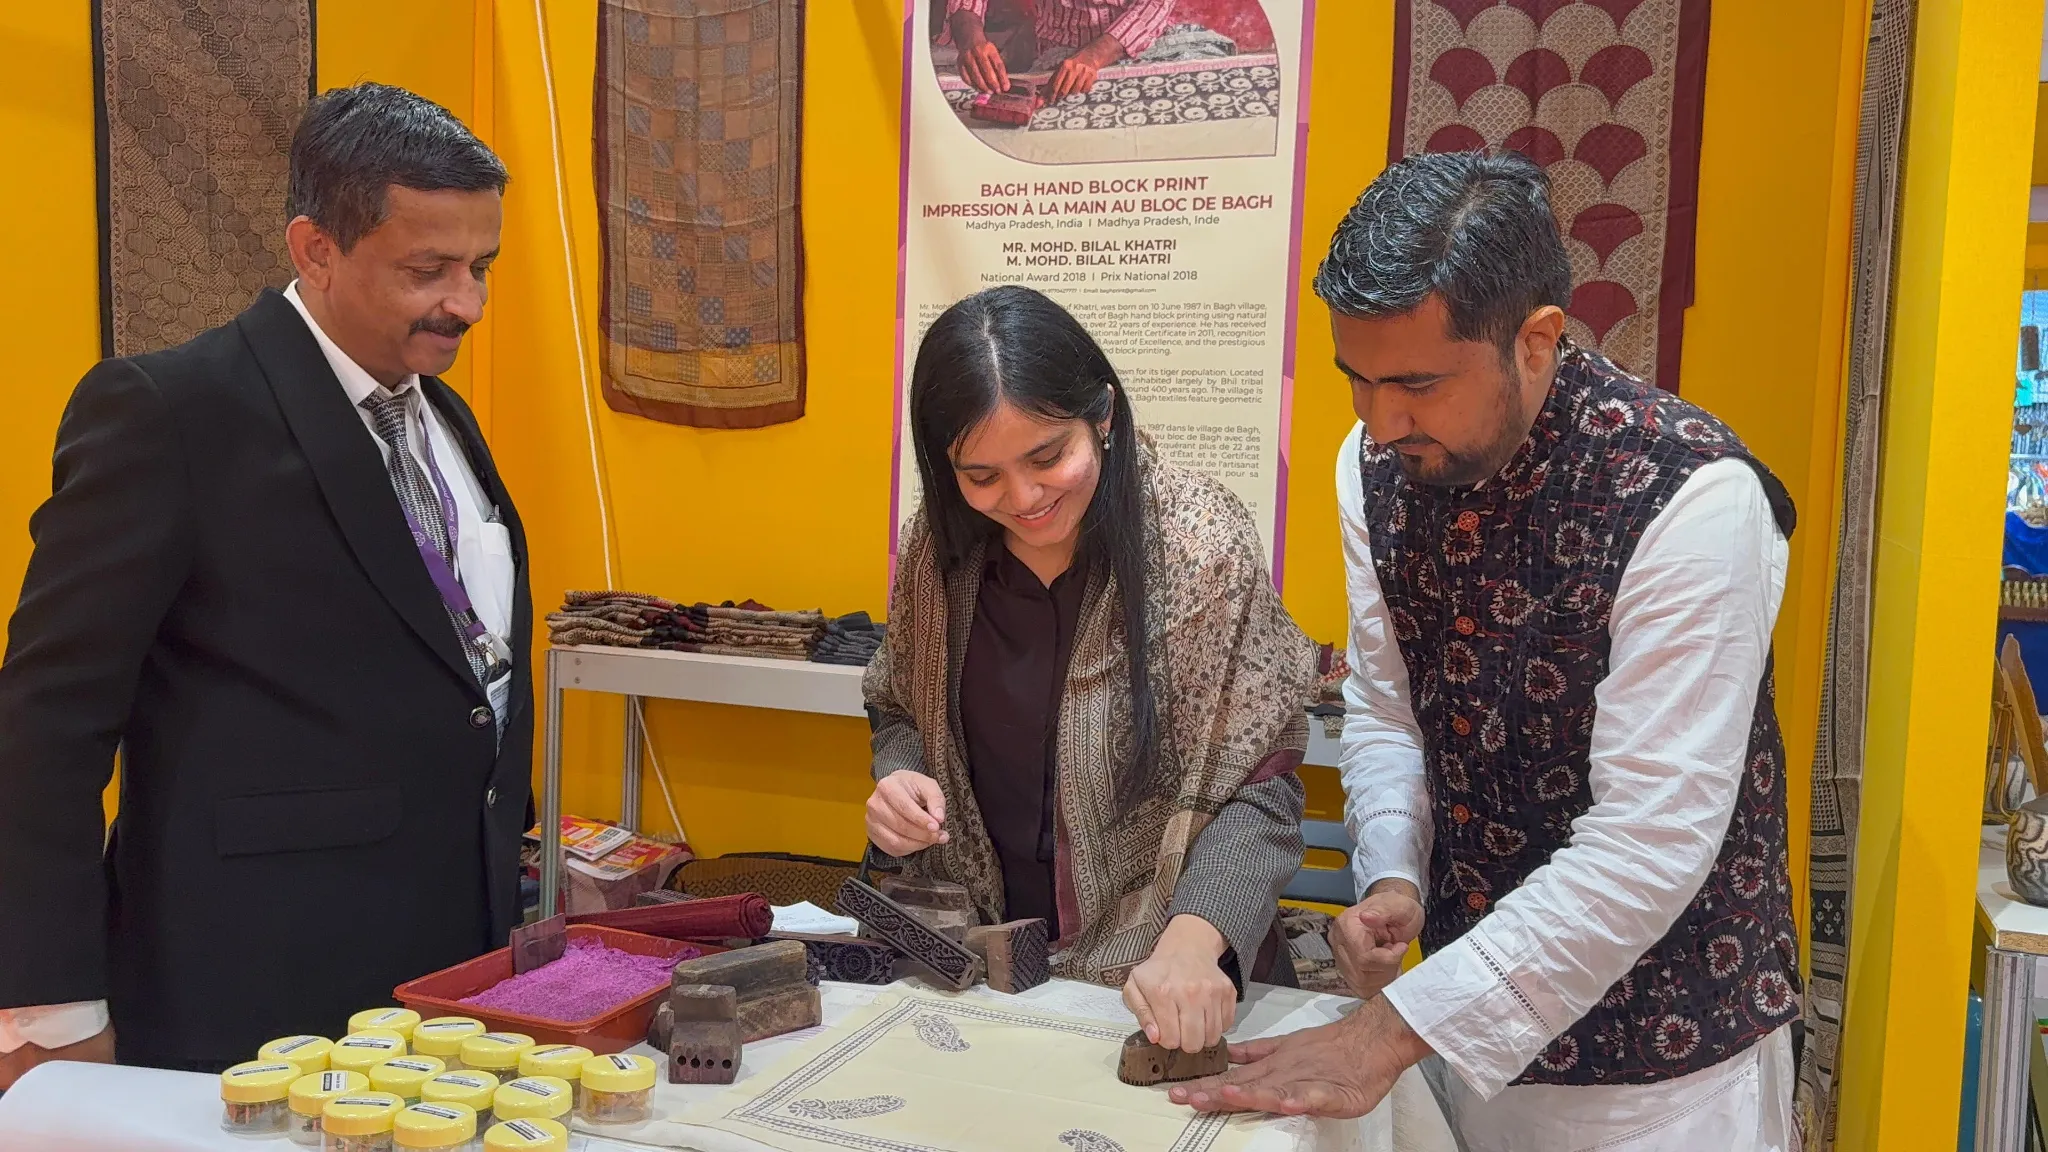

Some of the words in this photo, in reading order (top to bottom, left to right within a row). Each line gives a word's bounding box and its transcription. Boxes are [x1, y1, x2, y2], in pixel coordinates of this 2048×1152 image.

[981, 182, 1028, 197] BAGH
[1033, 180, 1084, 195] HAND
[1089, 178, 1149, 194] BLOCK
[1154, 176, 1209, 192] PRINT
[922, 201, 1018, 217] IMPRESSION
[1022, 197, 1034, 215] À
[1039, 200, 1059, 214] LA
[1064, 199, 1106, 214] MAIN
[1110, 198, 1135, 212] AU
[1140, 197, 1187, 212] BLOC
[1192, 196, 1216, 210] DE
[1221, 195, 1272, 210] BAGH
[965, 219, 1006, 232] Madhya
[1008, 218, 1054, 230] Pradesh,
[1056, 217, 1083, 228] India
[1097, 216, 1140, 229] Madhya
[1143, 215, 1191, 227] Pradesh,
[1194, 214, 1220, 225] Inde
[1002, 241, 1026, 253] MR.
[1030, 240, 1077, 252] MOHD.
[1081, 240, 1121, 251] BILAL
[1124, 239, 1176, 251] KHATRI
[1006, 255, 1021, 266] M.
[1025, 254, 1071, 266] MOHD.
[1075, 254, 1115, 265] BILAL
[1119, 253, 1170, 265] KHATRI
[980, 271, 1024, 282] National
[1025, 271, 1060, 281] Award
[1062, 271, 1086, 281] 2018
[1100, 270, 1121, 281] Prix
[1123, 270, 1170, 280] National
[1172, 270, 1197, 280] 2018
[1073, 302, 1099, 311] Khatri,
[1117, 302, 1137, 310] born
[1150, 302, 1160, 310] 10
[1161, 301, 1181, 310] June
[1183, 301, 1202, 310] 1987
[1203, 301, 1211, 310] in
[1213, 301, 1236, 311] Bagh
[1237, 301, 1267, 311] village,
[1078, 311, 1097, 319] craft
[1097, 311, 1106, 319] of
[1107, 311, 1129, 321] Bagh
[1130, 310, 1152, 319] hand
[1152, 310, 1175, 319] block
[1176, 310, 1210, 320] printing
[1211, 310, 1235, 320] using
[1236, 310, 1267, 318] natural
[1107, 319, 1117, 327] 22
[1118, 321, 1140, 329] years
[1141, 319, 1150, 327] of
[1151, 319, 1196, 329] experience.
[1199, 319, 1212, 327] He
[1213, 319, 1229, 327] has
[1230, 319, 1266, 327] received
[1122, 328, 1143, 336] Merit
[1144, 328, 1187, 336] Certificate
[1188, 328, 1196, 336] in
[1197, 328, 1216, 337] 2011,
[1217, 328, 1266, 338] recognition
[1102, 337, 1128, 345] Award
[1129, 337, 1138, 345] of
[1139, 337, 1183, 347] Excellence,
[1184, 337, 1201, 345] and
[1202, 337, 1217, 345] the
[1218, 337, 1265, 347] prestigious
[1115, 345, 1137, 354] block
[1137, 345, 1172, 356] printing.
[1135, 367, 1147, 375] for
[1148, 367, 1159, 375] its
[1159, 367, 1179, 377] tiger
[1180, 367, 1227, 378] population.
[1229, 368, 1264, 376] Located
[1175, 376, 1203, 386] largely
[1206, 376, 1217, 386] by
[1220, 376, 1237, 384] Bhil
[1241, 376, 1263, 385] tribal
[1150, 384, 1167, 392] 400
[1168, 386, 1190, 395] years
[1191, 386, 1208, 395] ago.
[1210, 385, 1226, 393] The
[1227, 385, 1254, 396] village
[1256, 386, 1263, 394] is
[1135, 392, 1158, 403] Bagh
[1158, 393, 1187, 402] textiles
[1188, 393, 1218, 402] feature
[1218, 394, 1262, 405] geometric
[1147, 422, 1165, 431] 1987
[1165, 423, 1186, 431] dans
[1187, 423, 1195, 431] le
[1195, 423, 1223, 434] village
[1223, 424, 1235, 432] de
[1236, 424, 1261, 435] Bagh,
[1166, 431, 1184, 440] bloc
[1186, 432, 1197, 440] de
[1199, 432, 1222, 443] Bagh
[1245, 433, 1260, 442] des
[1198, 441, 1217, 452] plus
[1218, 442, 1230, 450] de
[1232, 442, 1243, 450] 22
[1169, 447, 1193, 458] d'État
[1209, 450, 1218, 458] le
[1220, 450, 1260, 459] Certificat
[1205, 459, 1217, 467] de
[1218, 459, 1259, 468] l'artisanat
[1225, 470, 1245, 479] pour
